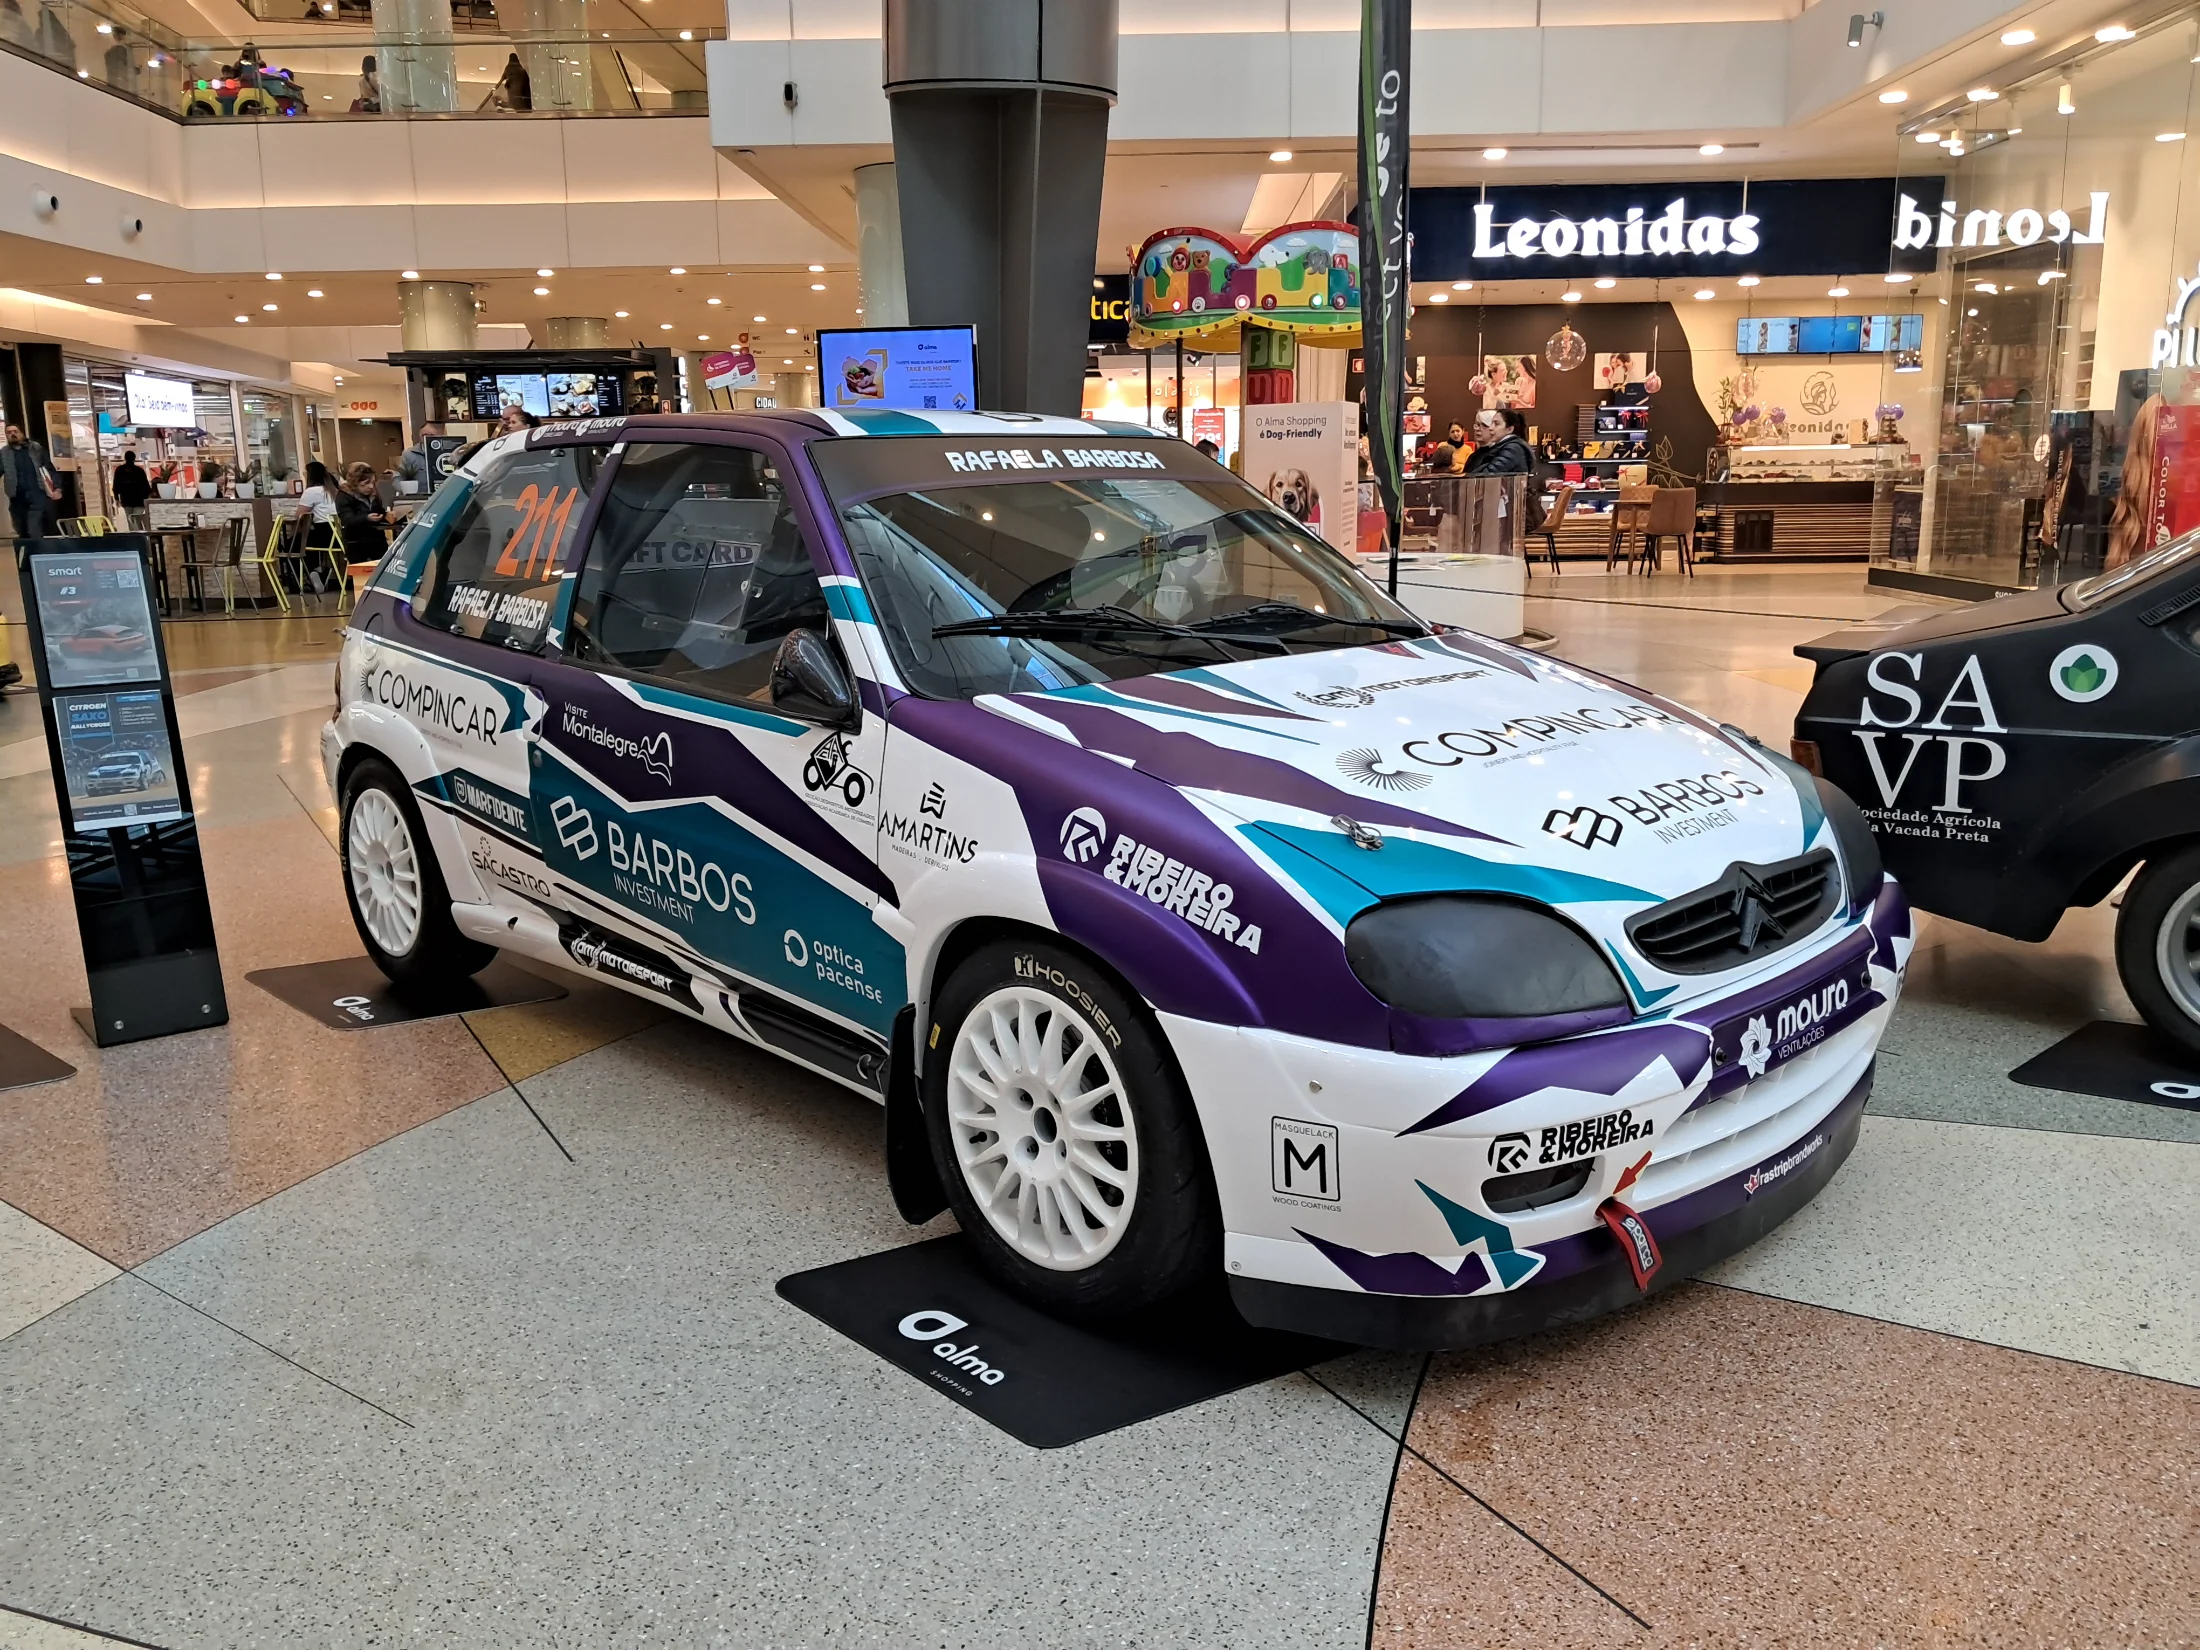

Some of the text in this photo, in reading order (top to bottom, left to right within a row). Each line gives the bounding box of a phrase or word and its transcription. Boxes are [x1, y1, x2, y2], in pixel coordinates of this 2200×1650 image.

[1472, 197, 1760, 258] Leonidas
[1255, 415, 1327, 427] O Alma Shopping
[1259, 428, 1323, 440] é Dog-Friendly
[945, 448, 1167, 472] RAFAELA BARBOSA
[2158, 456, 2170, 509] COLOR
[494, 483, 578, 582] 211
[671, 541, 754, 563] CARD
[48, 567, 82, 577] smart
[60, 586, 76, 595] #3
[447, 585, 549, 631] RAFAELA BARBOSA
[379, 670, 497, 746] COMPINCAR
[564, 701, 589, 719] VISITE
[1859, 651, 2009, 734] SA
[70, 721, 110, 730] RALLYCROSS
[71, 711, 107, 722] SAXO
[562, 712, 639, 758] Montalegre
[1402, 705, 1687, 767] COMPINCAR
[1851, 730, 2007, 814] VP
[466, 783, 528, 833] MARFIDENTE
[1653, 808, 1740, 845] INVESTMENT
[1858, 805, 2002, 830] ociedade Agrícola
[891, 844, 917, 859] MADEIRAS
[1883, 821, 1941, 838] Vacada
[1945, 827, 1990, 843] Preta
[471, 850, 551, 898] SACASTRO
[607, 820, 757, 926] BARBOS
[1111, 833, 1234, 911] RIBEIRO
[613, 872, 694, 925] INVESTMENT
[813, 940, 864, 975] optica
[815, 961, 883, 1005] pacense
[1035, 961, 1122, 1050] HOOSIER
[1775, 978, 1849, 1045] moura
[1778, 1025, 1825, 1060] VENTILAÇÕES
[1274, 1122, 1335, 1140] MASQUELACK
[1540, 1109, 1632, 1148] RIBEIRO
[1284, 1137, 1327, 1194] M
[1759, 1133, 1824, 1186] rastripbrandworks
[1272, 1195, 1342, 1213] WOOD COATINGS
[1621, 1216, 1655, 1271] sparco
[929, 1370, 973, 1397] SHOPPING
[932, 1342, 1005, 1386] alma
